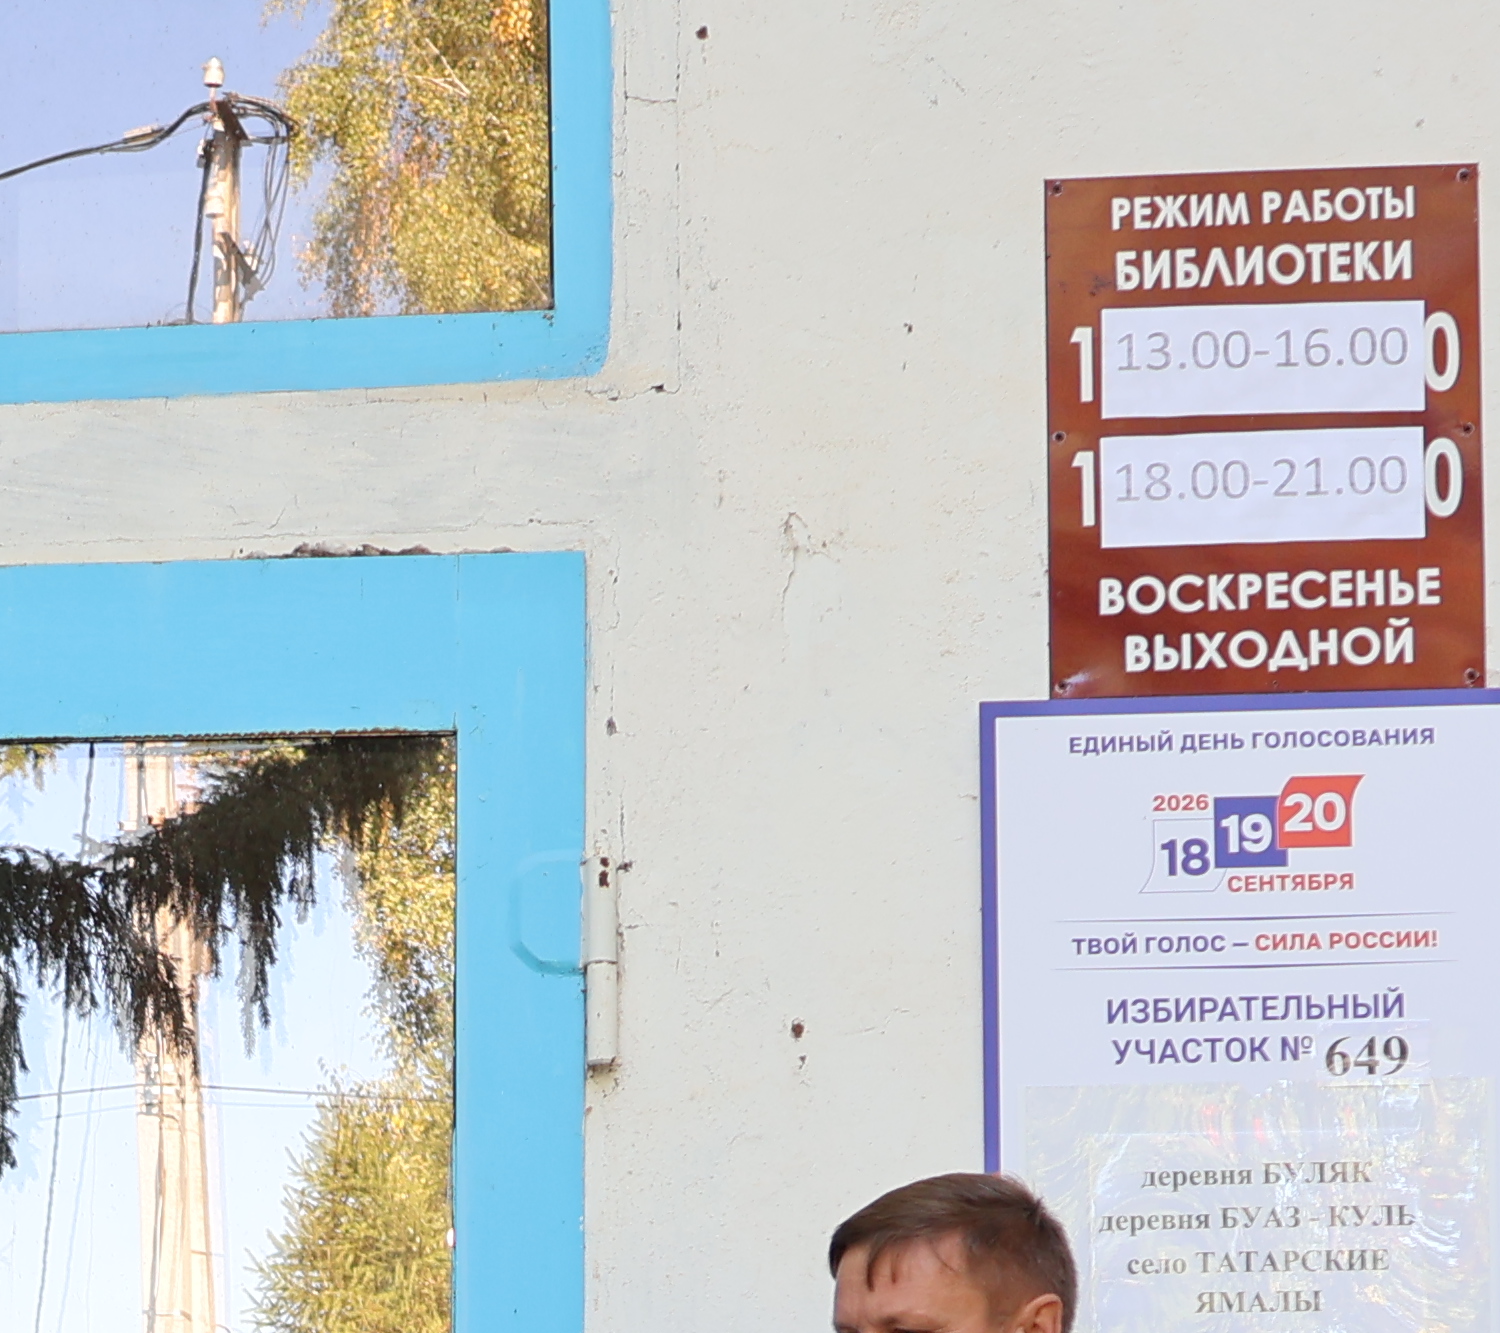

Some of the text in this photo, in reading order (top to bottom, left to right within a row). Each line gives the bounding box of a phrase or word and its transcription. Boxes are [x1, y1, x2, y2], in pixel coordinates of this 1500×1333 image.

[1110, 185, 1416, 231] РЕЖИМ РАБОТЫ
[1115, 239, 1414, 291] БИБЛИОТЕКИ
[1116, 326, 1410, 372] 13.00-16.00
[1115, 455, 1409, 502] 18.00-21.00
[1099, 566, 1442, 616] ВОСКРЕСЕНЬЕ
[1125, 617, 1415, 673] ВЫХОДНОЙ
[1069, 727, 1435, 756] ЕДИНЫЙ ДЕНЬ ГОЛОСОВАНИЯ
[1152, 794, 1210, 812] 2026
[1161, 792, 1347, 877] 18 19 20
[1227, 872, 1355, 893] СЕНТЯБРЯ
[1072, 932, 1139, 955] ТВОЙ
[1145, 934, 1227, 955] ГОЛОС
[1254, 931, 1323, 953] СИЛА
[1329, 929, 1439, 950] РОССИИ!
[1106, 987, 1406, 1026] ИЗБИРАТЕЛЬНЫЙ
[1112, 1036, 1270, 1066] УЧАСТОК
[1325, 1034, 1410, 1077] 649
[1140, 1161, 1374, 1192] деревня БУЛЯК
[1098, 1211, 1211, 1237] деревня
[1219, 1206, 1301, 1231] БУАЗ
[1327, 1204, 1417, 1229] КУЛЬ
[1126, 1248, 1390, 1277] село ТАТАРСКИЕ
[1195, 1290, 1323, 1315] ЯМАЛЫ
